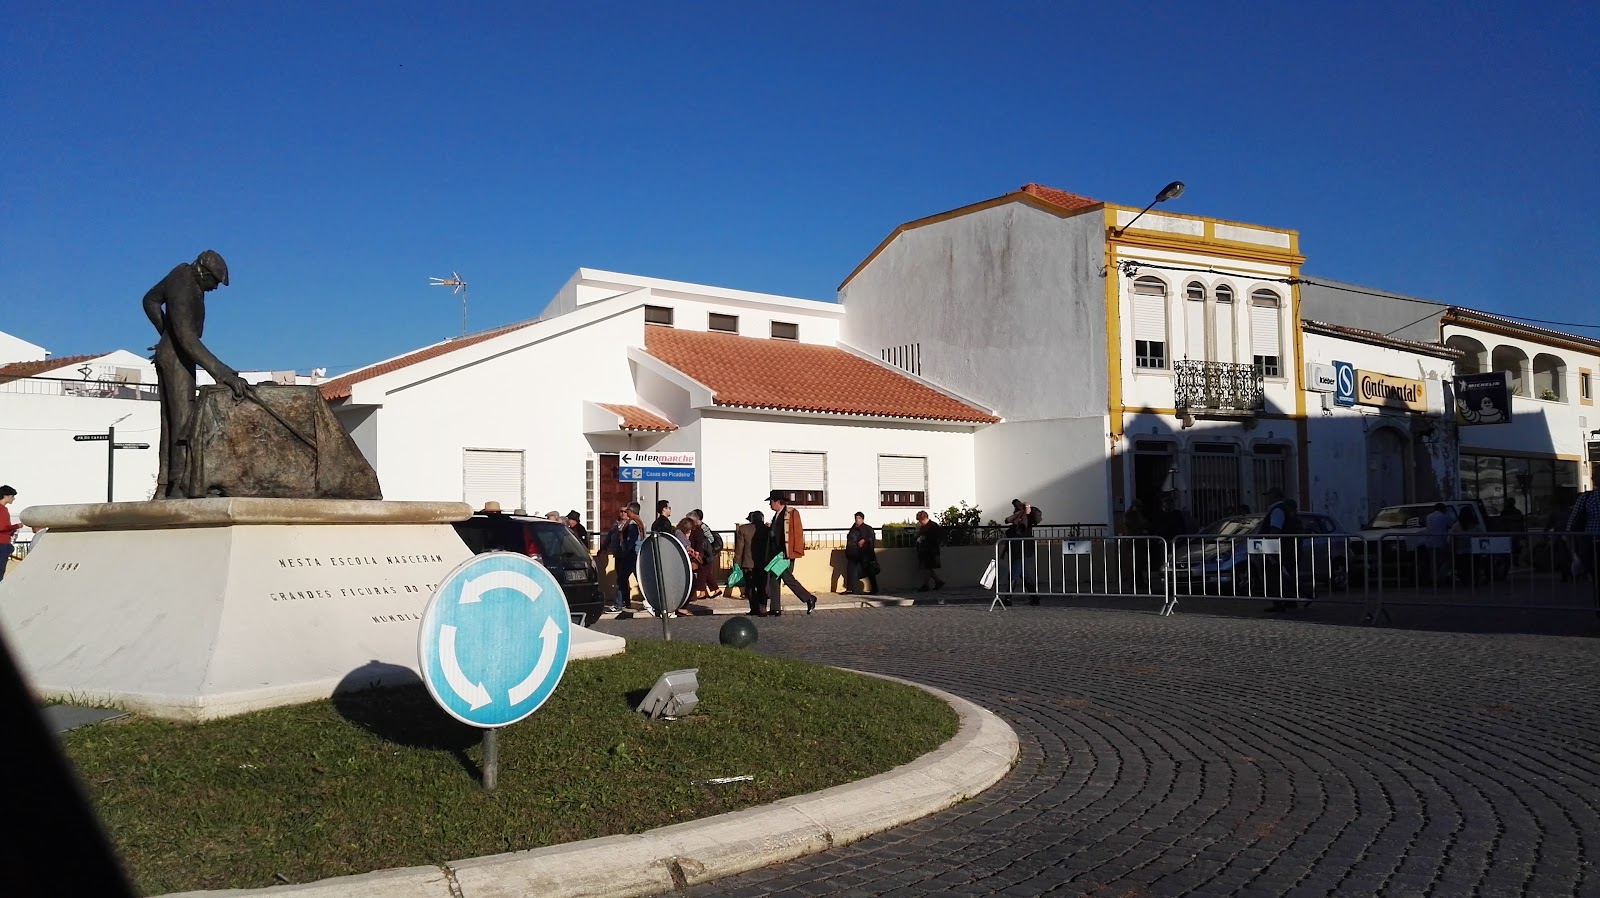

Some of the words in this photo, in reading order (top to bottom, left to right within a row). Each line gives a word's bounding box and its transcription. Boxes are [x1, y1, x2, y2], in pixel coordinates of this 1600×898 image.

[1361, 376, 1417, 403] Continental
[278, 557, 322, 568] NESTA
[330, 556, 378, 567] ESCOLA
[386, 554, 443, 565] NASCERAM
[269, 590, 332, 601] GRANDES
[340, 586, 397, 597] FIGURAS
[404, 585, 419, 593] DO
[371, 611, 424, 624] MUNDIA
